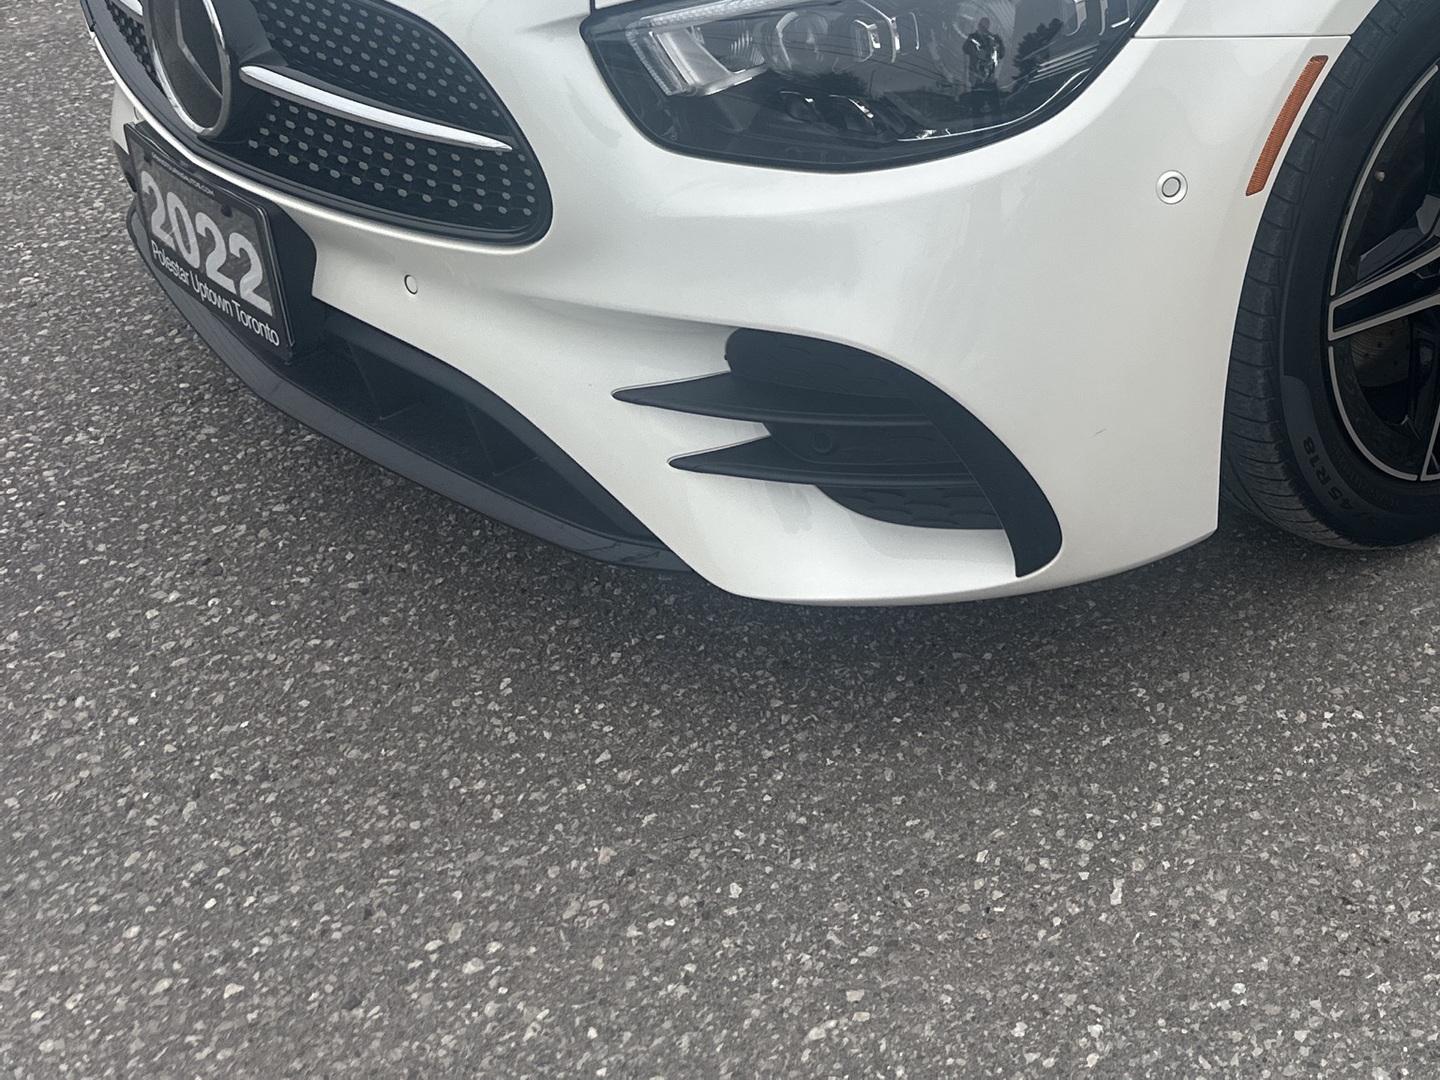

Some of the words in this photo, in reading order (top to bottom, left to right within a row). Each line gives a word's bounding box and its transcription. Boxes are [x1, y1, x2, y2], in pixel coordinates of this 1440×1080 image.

[140, 170, 273, 317] 2022
[151, 239, 191, 286] Polestar
[190, 268, 234, 317] Uptown
[231, 299, 280, 347] Toronto
